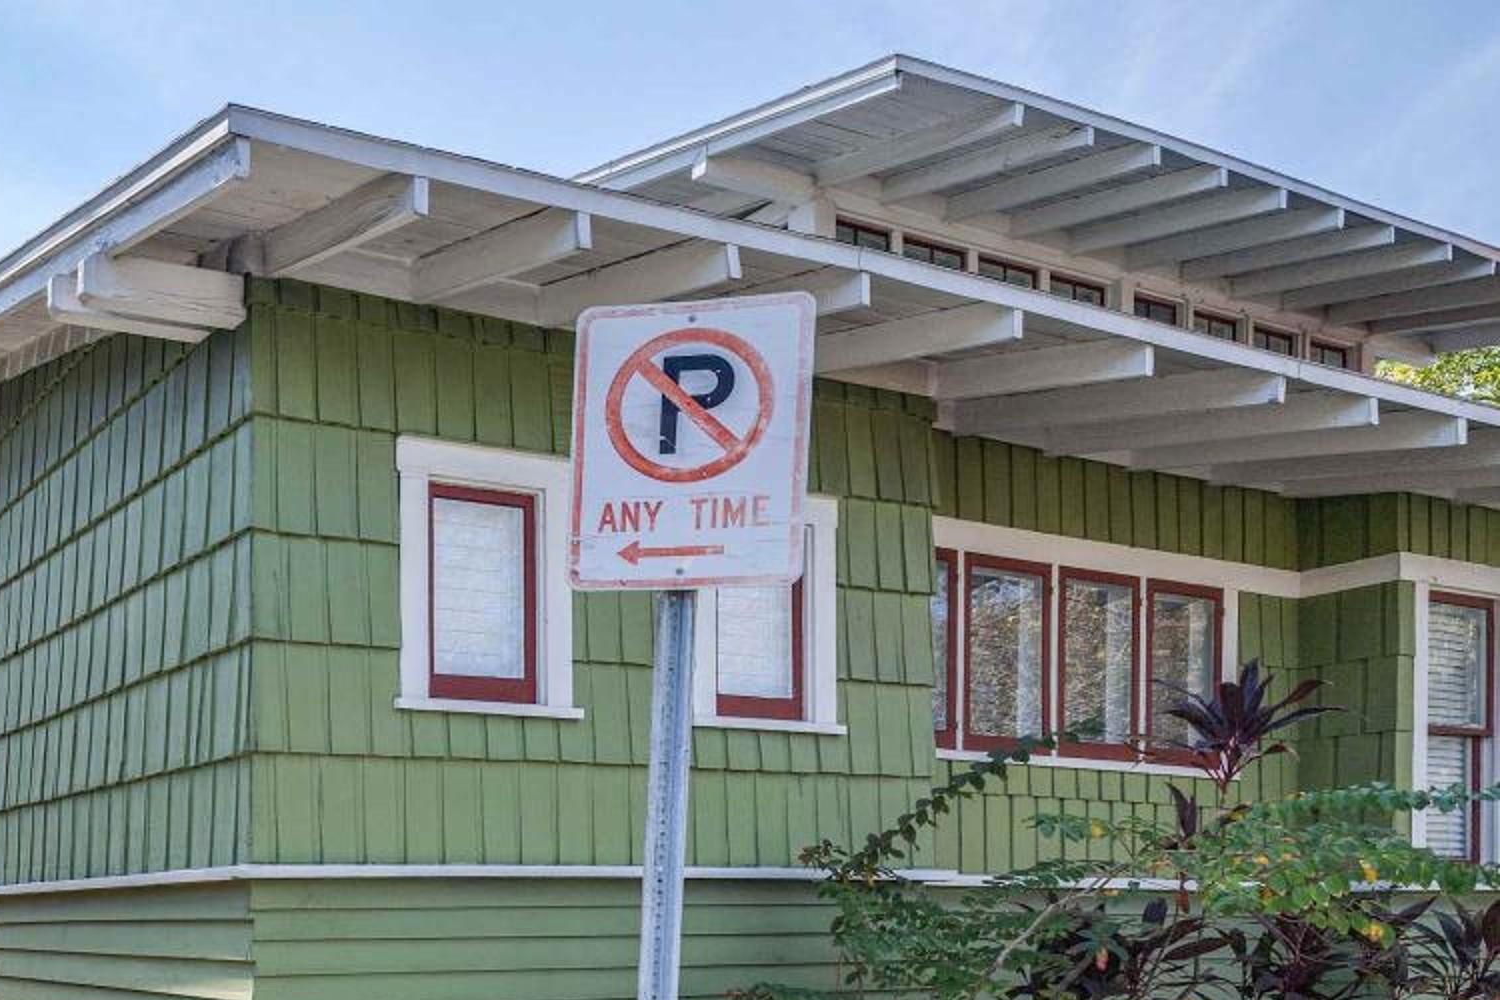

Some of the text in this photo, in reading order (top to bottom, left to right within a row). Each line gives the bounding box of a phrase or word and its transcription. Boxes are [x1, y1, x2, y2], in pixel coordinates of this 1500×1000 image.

[659, 353, 735, 455] P
[598, 496, 770, 532] ANY TIME
